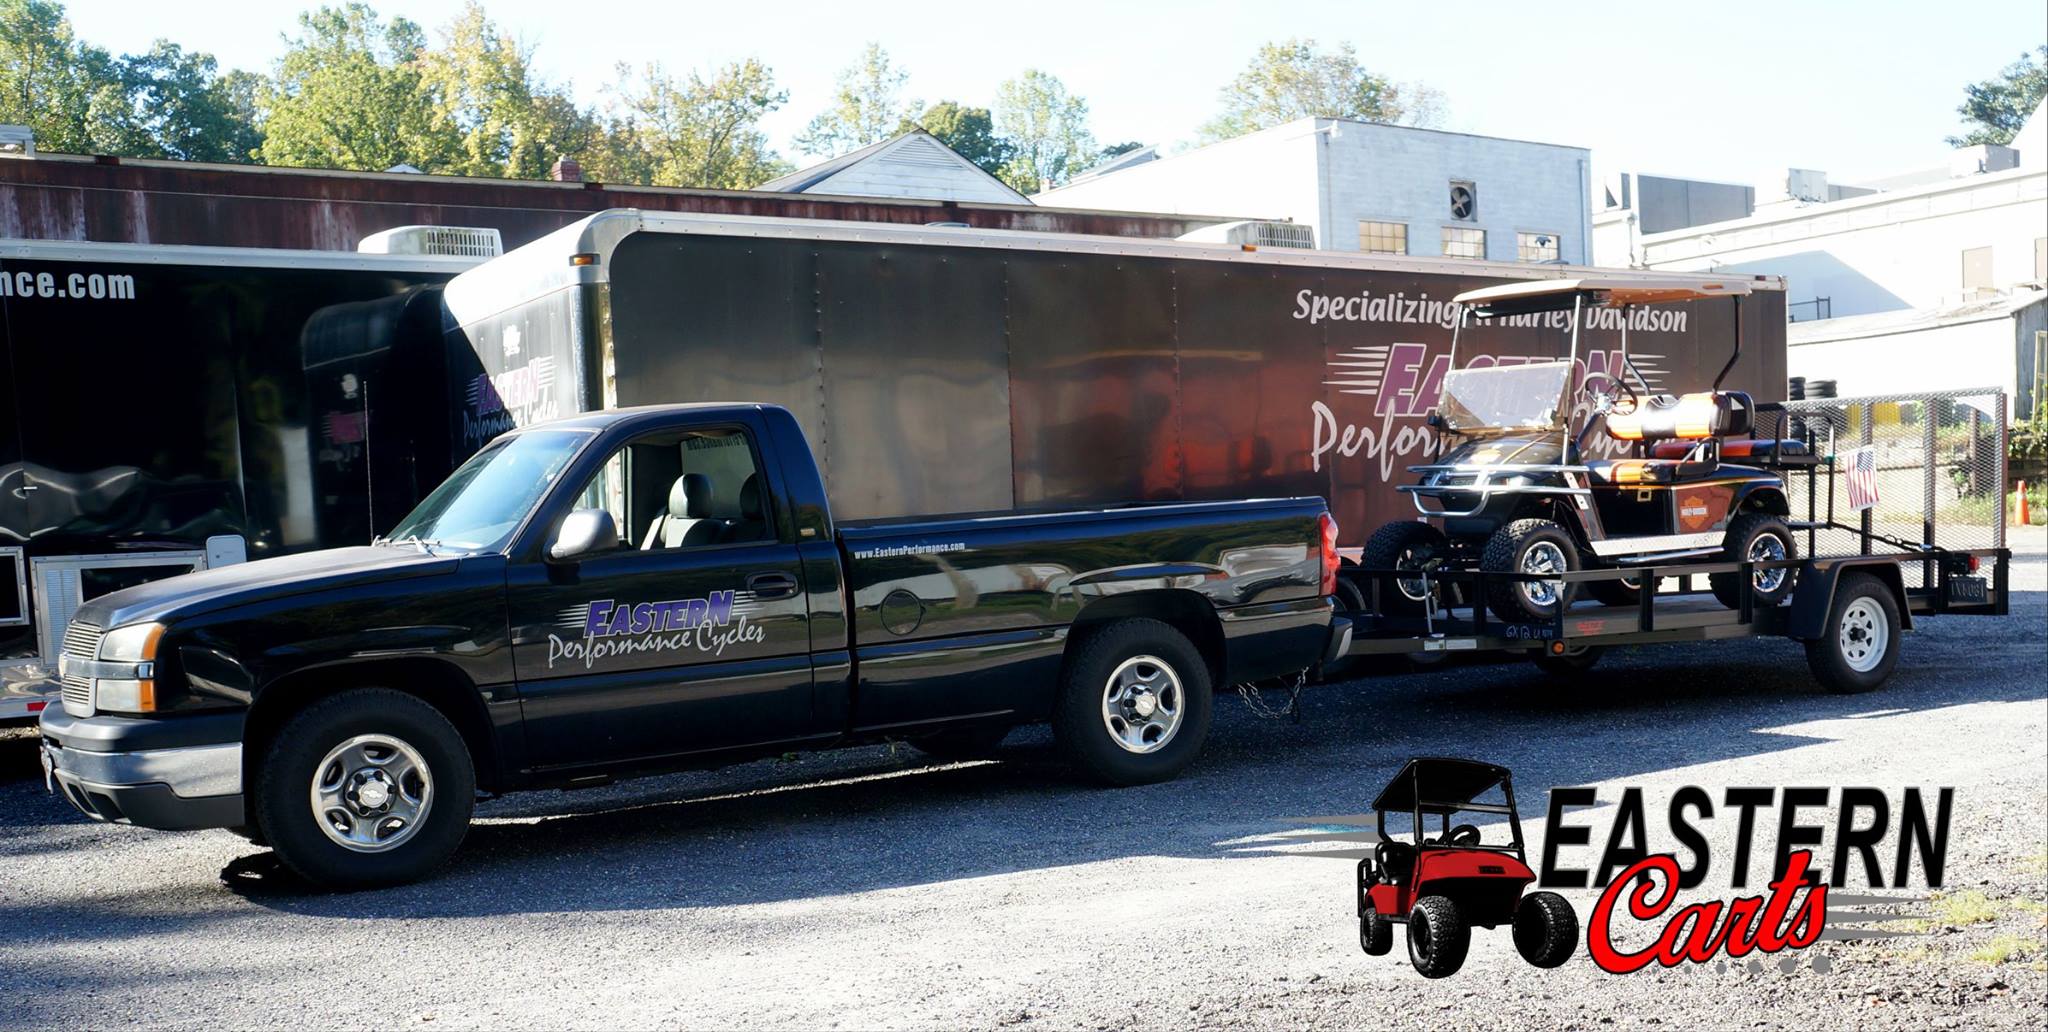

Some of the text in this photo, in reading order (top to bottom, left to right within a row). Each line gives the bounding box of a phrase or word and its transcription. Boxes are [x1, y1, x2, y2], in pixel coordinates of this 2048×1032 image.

[0, 271, 135, 299] nce.com
[1293, 289, 1459, 329] Specializing
[854, 542, 966, 559] www.EasternPerformance.com
[583, 590, 735, 638] EASTERN
[548, 615, 766, 669] Performance Cycles
